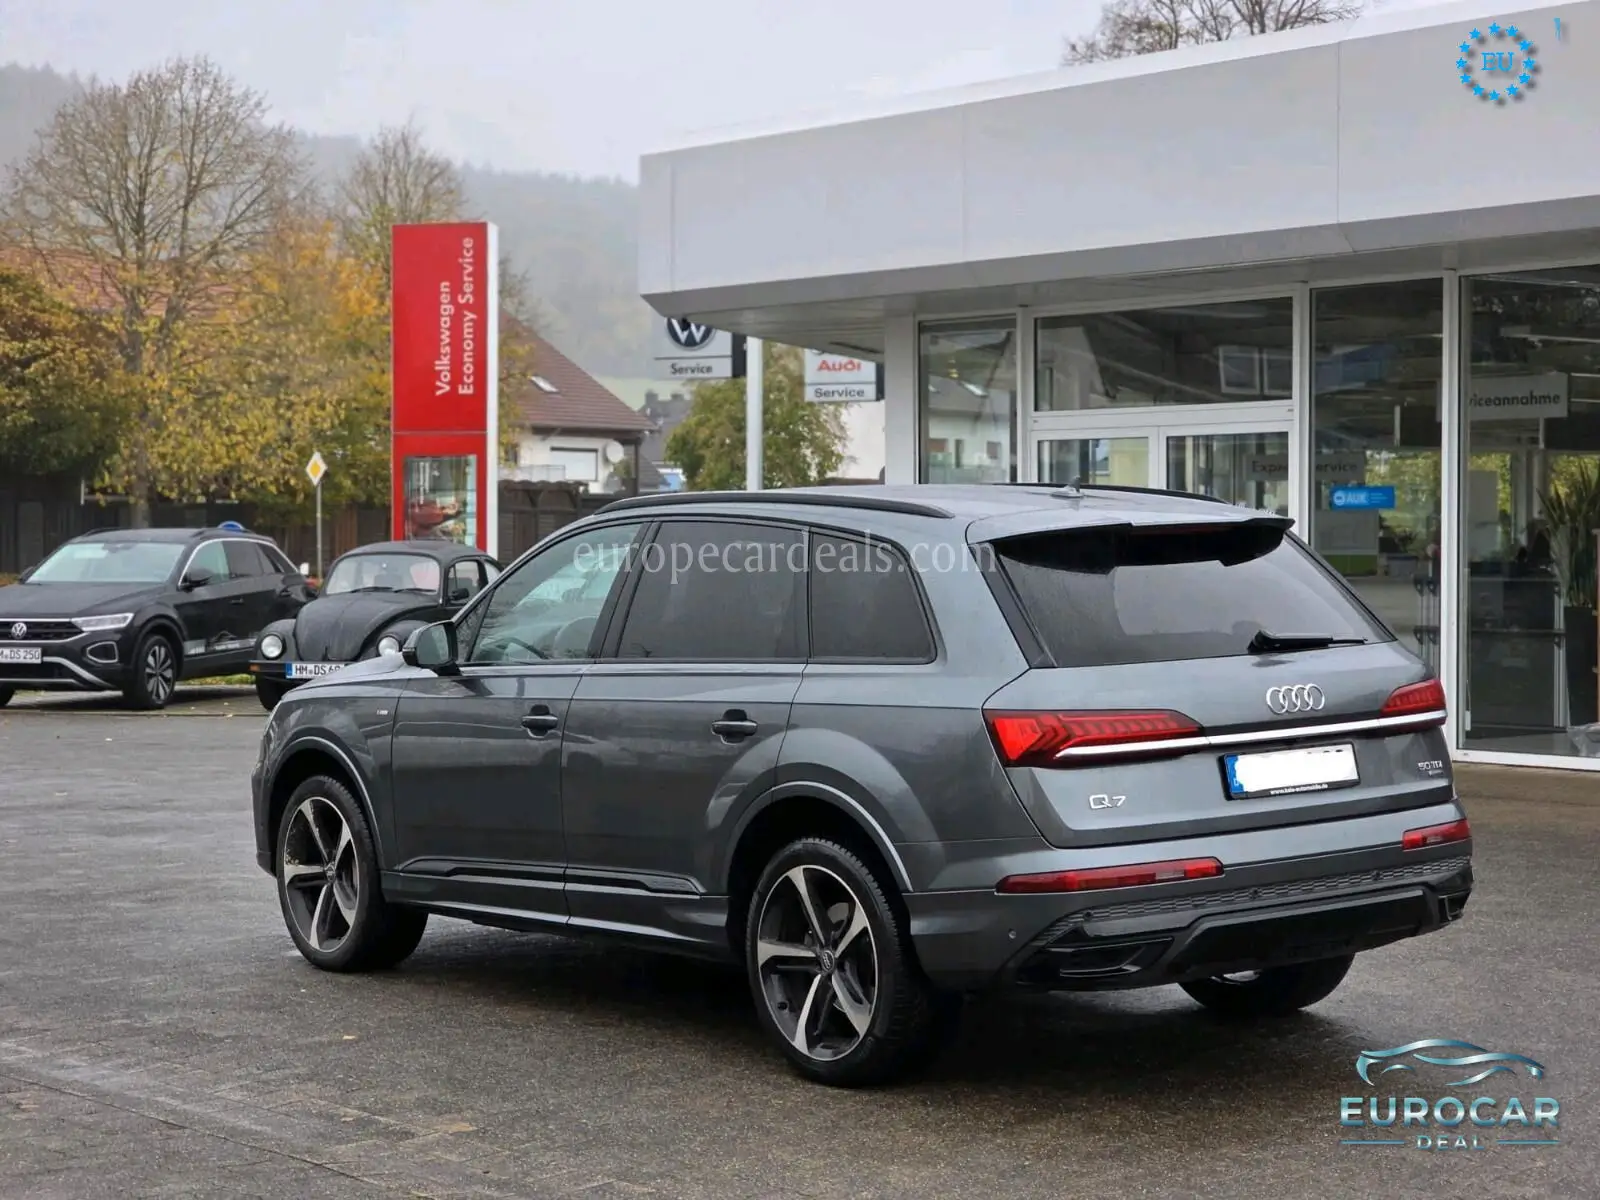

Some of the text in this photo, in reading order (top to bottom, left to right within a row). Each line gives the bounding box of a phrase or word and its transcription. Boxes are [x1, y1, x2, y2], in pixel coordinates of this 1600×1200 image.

[458, 237, 477, 395] Economy Service
[435, 281, 454, 396] Volkswagen
[670, 363, 713, 374] Service
[817, 360, 862, 372] Audi
[814, 387, 865, 397] Service
[1090, 794, 1125, 808] Q7
